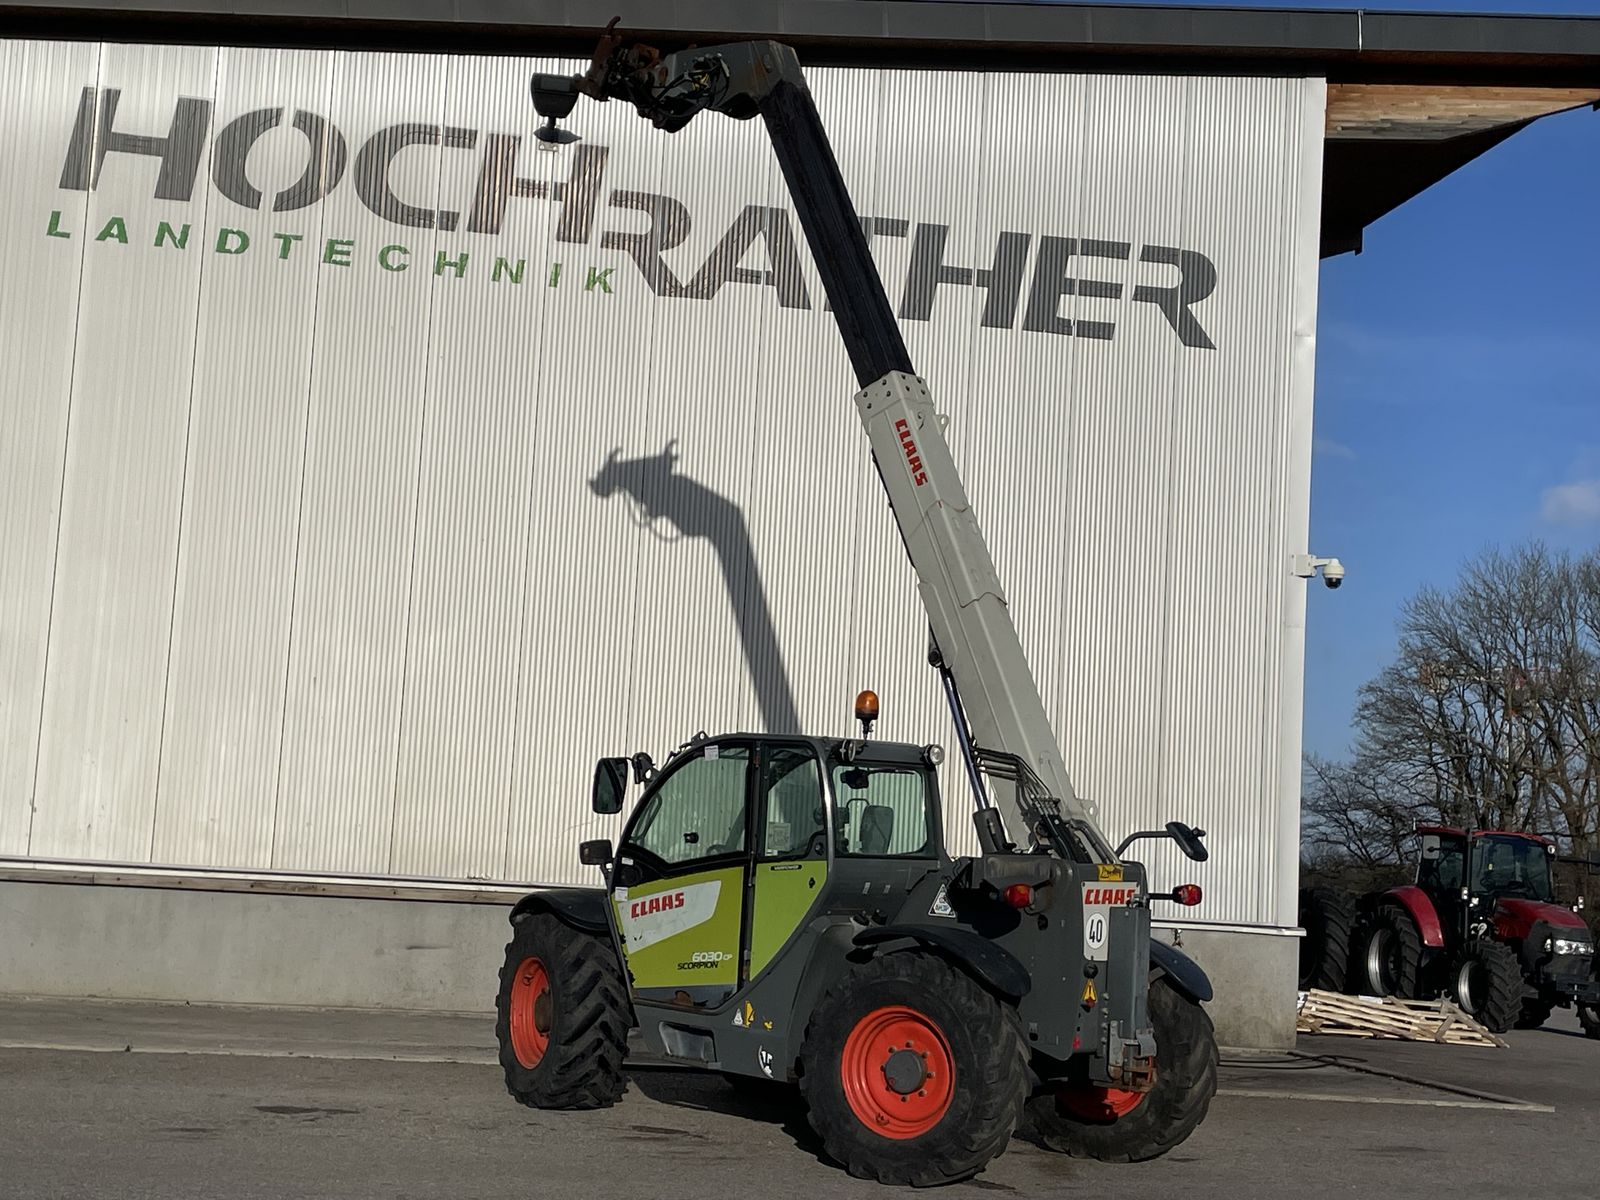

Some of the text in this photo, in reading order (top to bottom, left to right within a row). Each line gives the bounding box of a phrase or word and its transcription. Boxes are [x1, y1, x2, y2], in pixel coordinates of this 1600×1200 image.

[46, 210, 616, 295] LANDTECHNIK
[895, 419, 928, 486] CLAAS
[631, 893, 684, 918] CLAAS
[1089, 919, 1103, 943] 40
[678, 961, 719, 970] SCORPION
[692, 951, 723, 962] 6030
